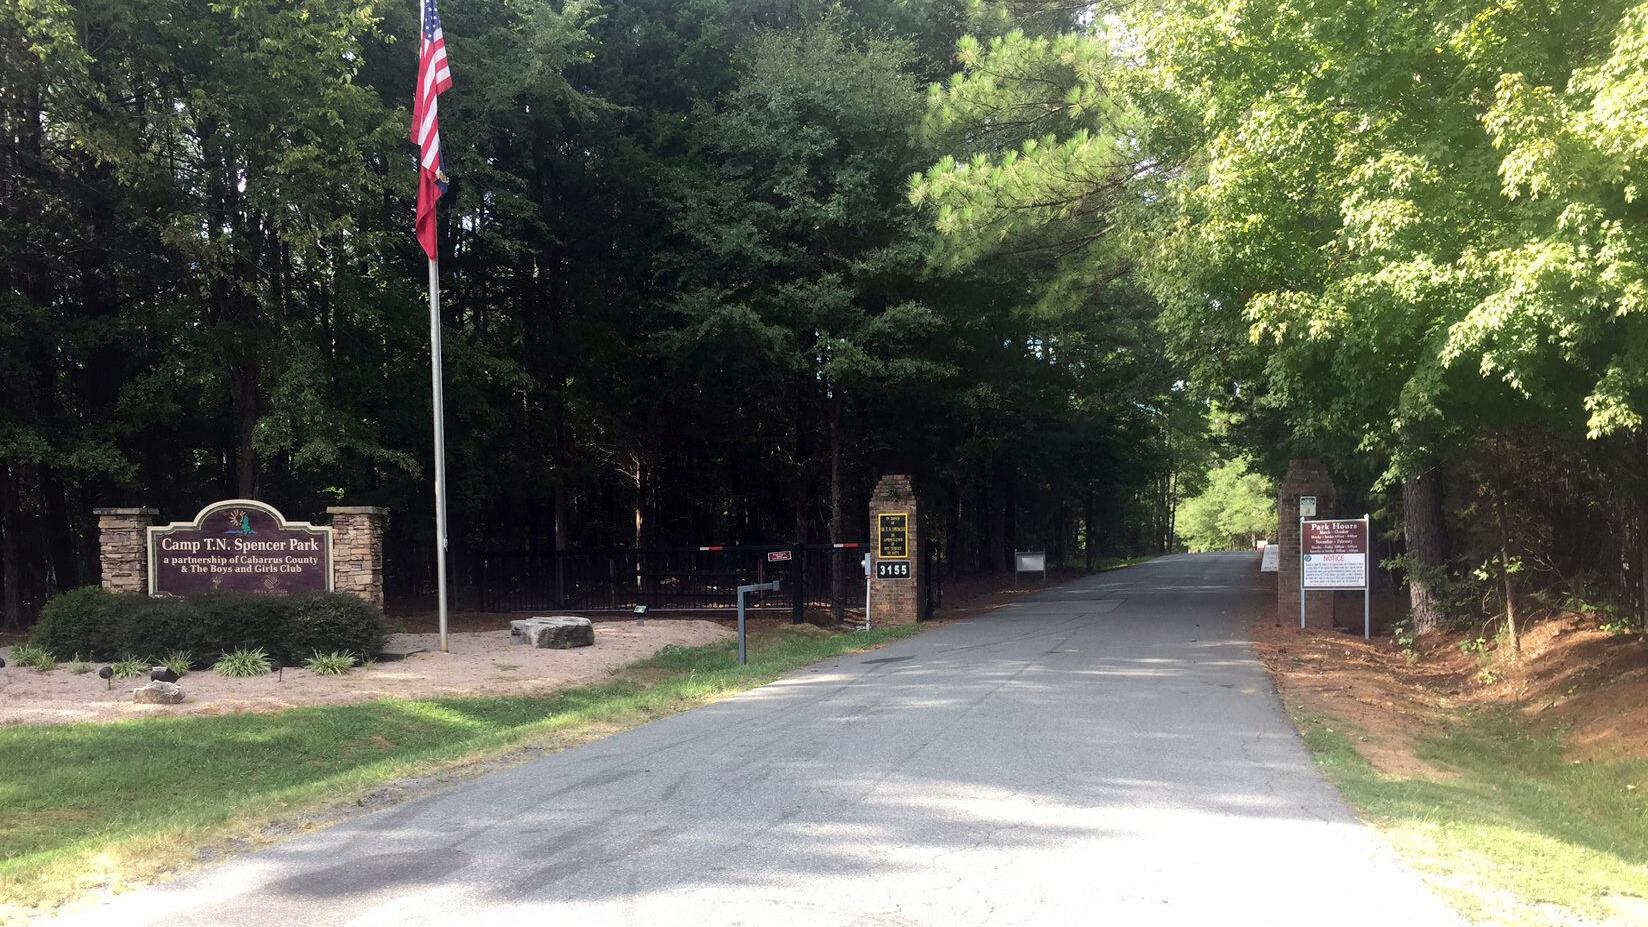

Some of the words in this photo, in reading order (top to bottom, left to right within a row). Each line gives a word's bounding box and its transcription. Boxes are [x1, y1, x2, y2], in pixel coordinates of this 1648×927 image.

[1332, 522, 1358, 530] Hours
[161, 538, 200, 553] Camp
[204, 538, 231, 551] T.N.
[234, 538, 285, 553] Spencer
[289, 538, 319, 551] Park
[171, 555, 227, 566] partnership
[229, 555, 239, 564] of
[240, 555, 283, 564] Cabarrus
[285, 555, 318, 566] County
[180, 565, 188, 573] &
[190, 565, 208, 573] The
[210, 565, 233, 575] Boys
[235, 565, 252, 573] and
[254, 565, 278, 573] Girls
[280, 565, 302, 573] Club
[880, 565, 907, 576] 3155
